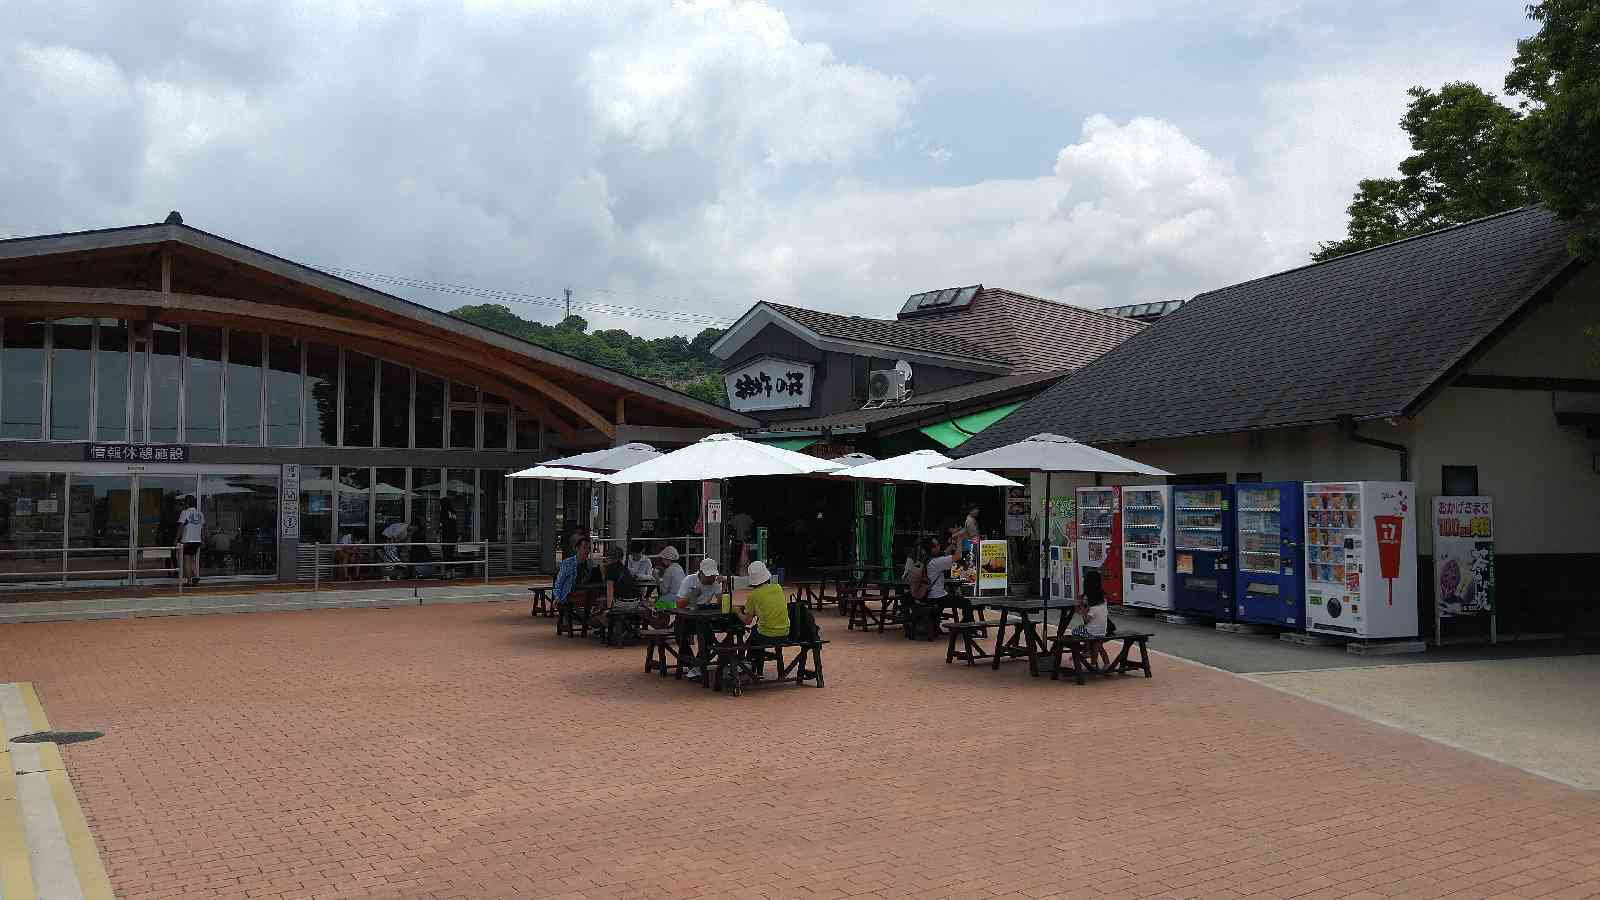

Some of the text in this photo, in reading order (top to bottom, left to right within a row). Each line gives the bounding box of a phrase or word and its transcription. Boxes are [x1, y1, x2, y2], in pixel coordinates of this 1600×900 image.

[90, 446, 184, 461] 情報休憩施設
[1438, 502, 1489, 515] おかげさまで
